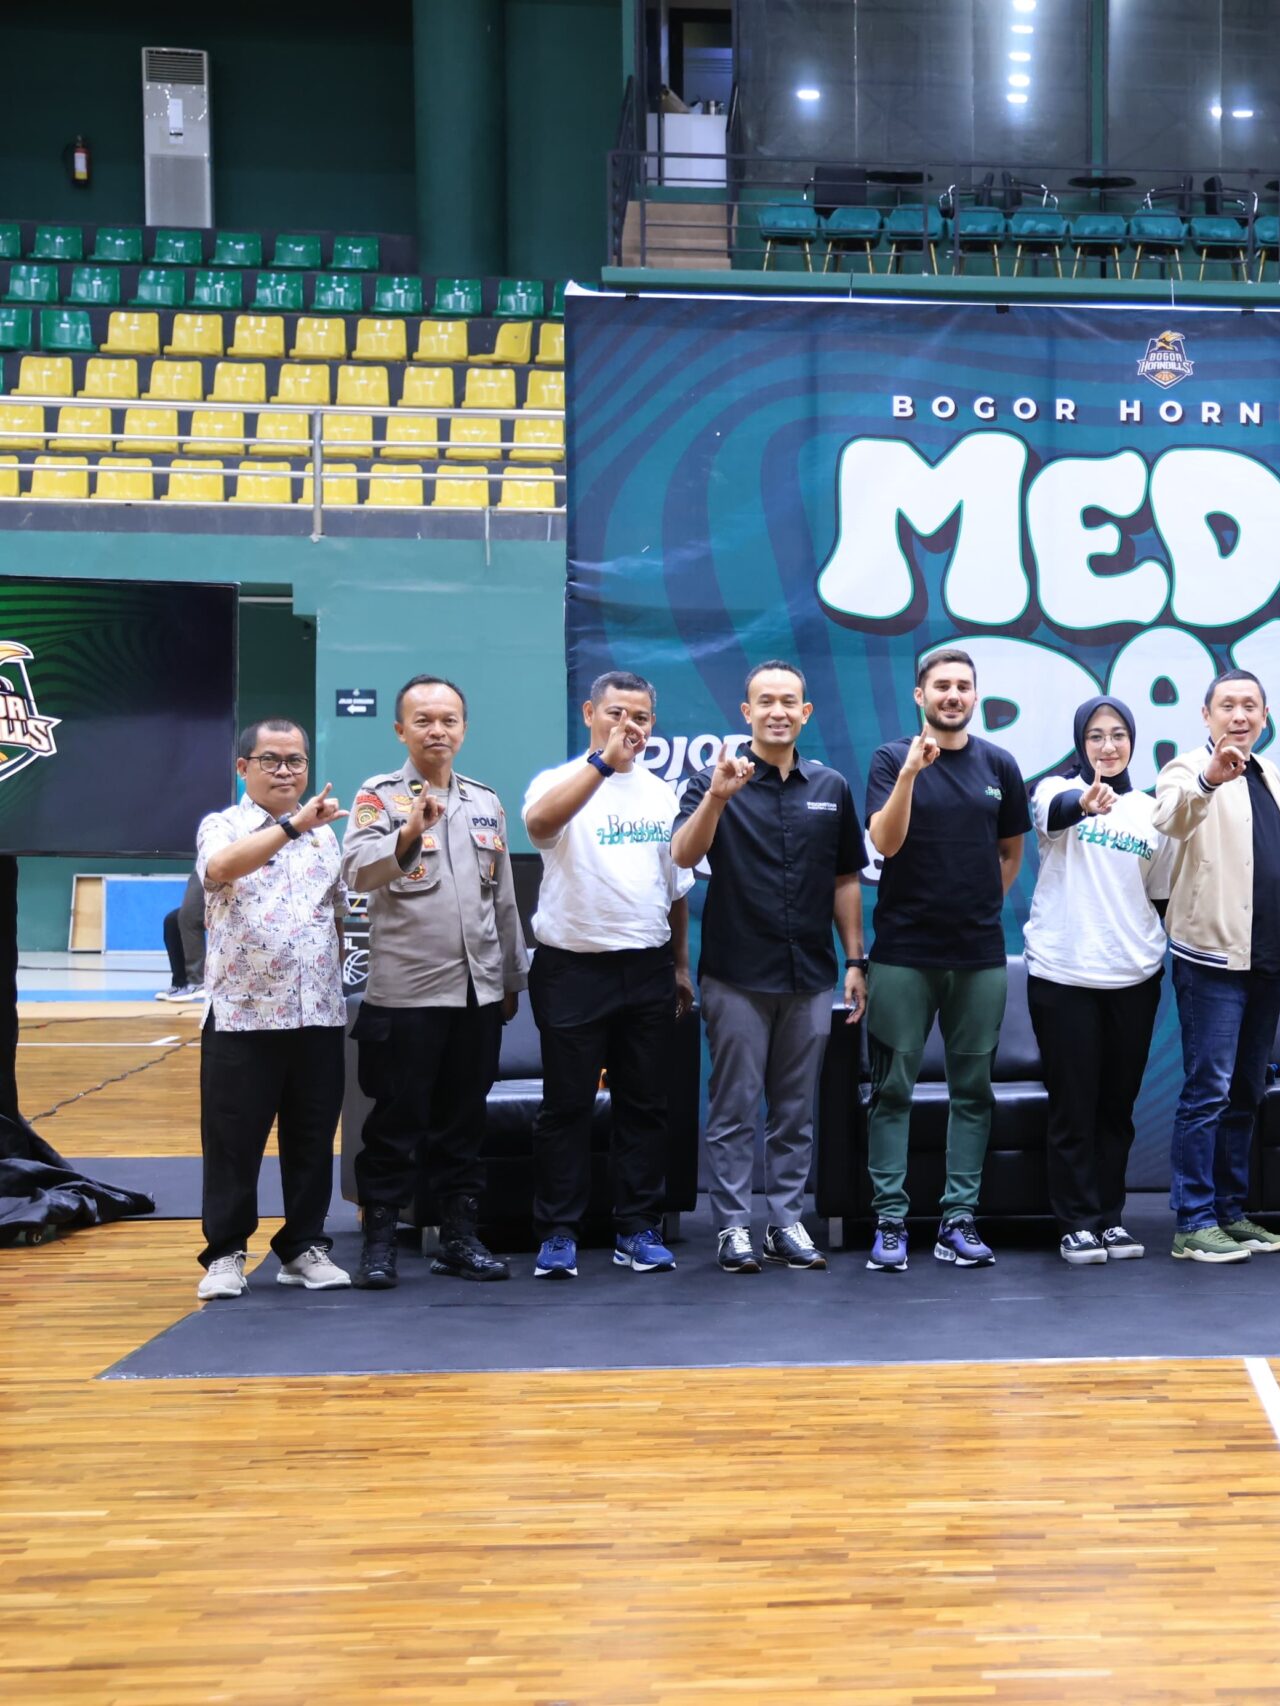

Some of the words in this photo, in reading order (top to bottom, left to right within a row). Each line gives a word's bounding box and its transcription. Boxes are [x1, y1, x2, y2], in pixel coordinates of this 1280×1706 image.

[1149, 352, 1183, 362] BOGOR
[1141, 361, 1191, 374] HORNBILLS
[892, 395, 1076, 420] BOGOR
